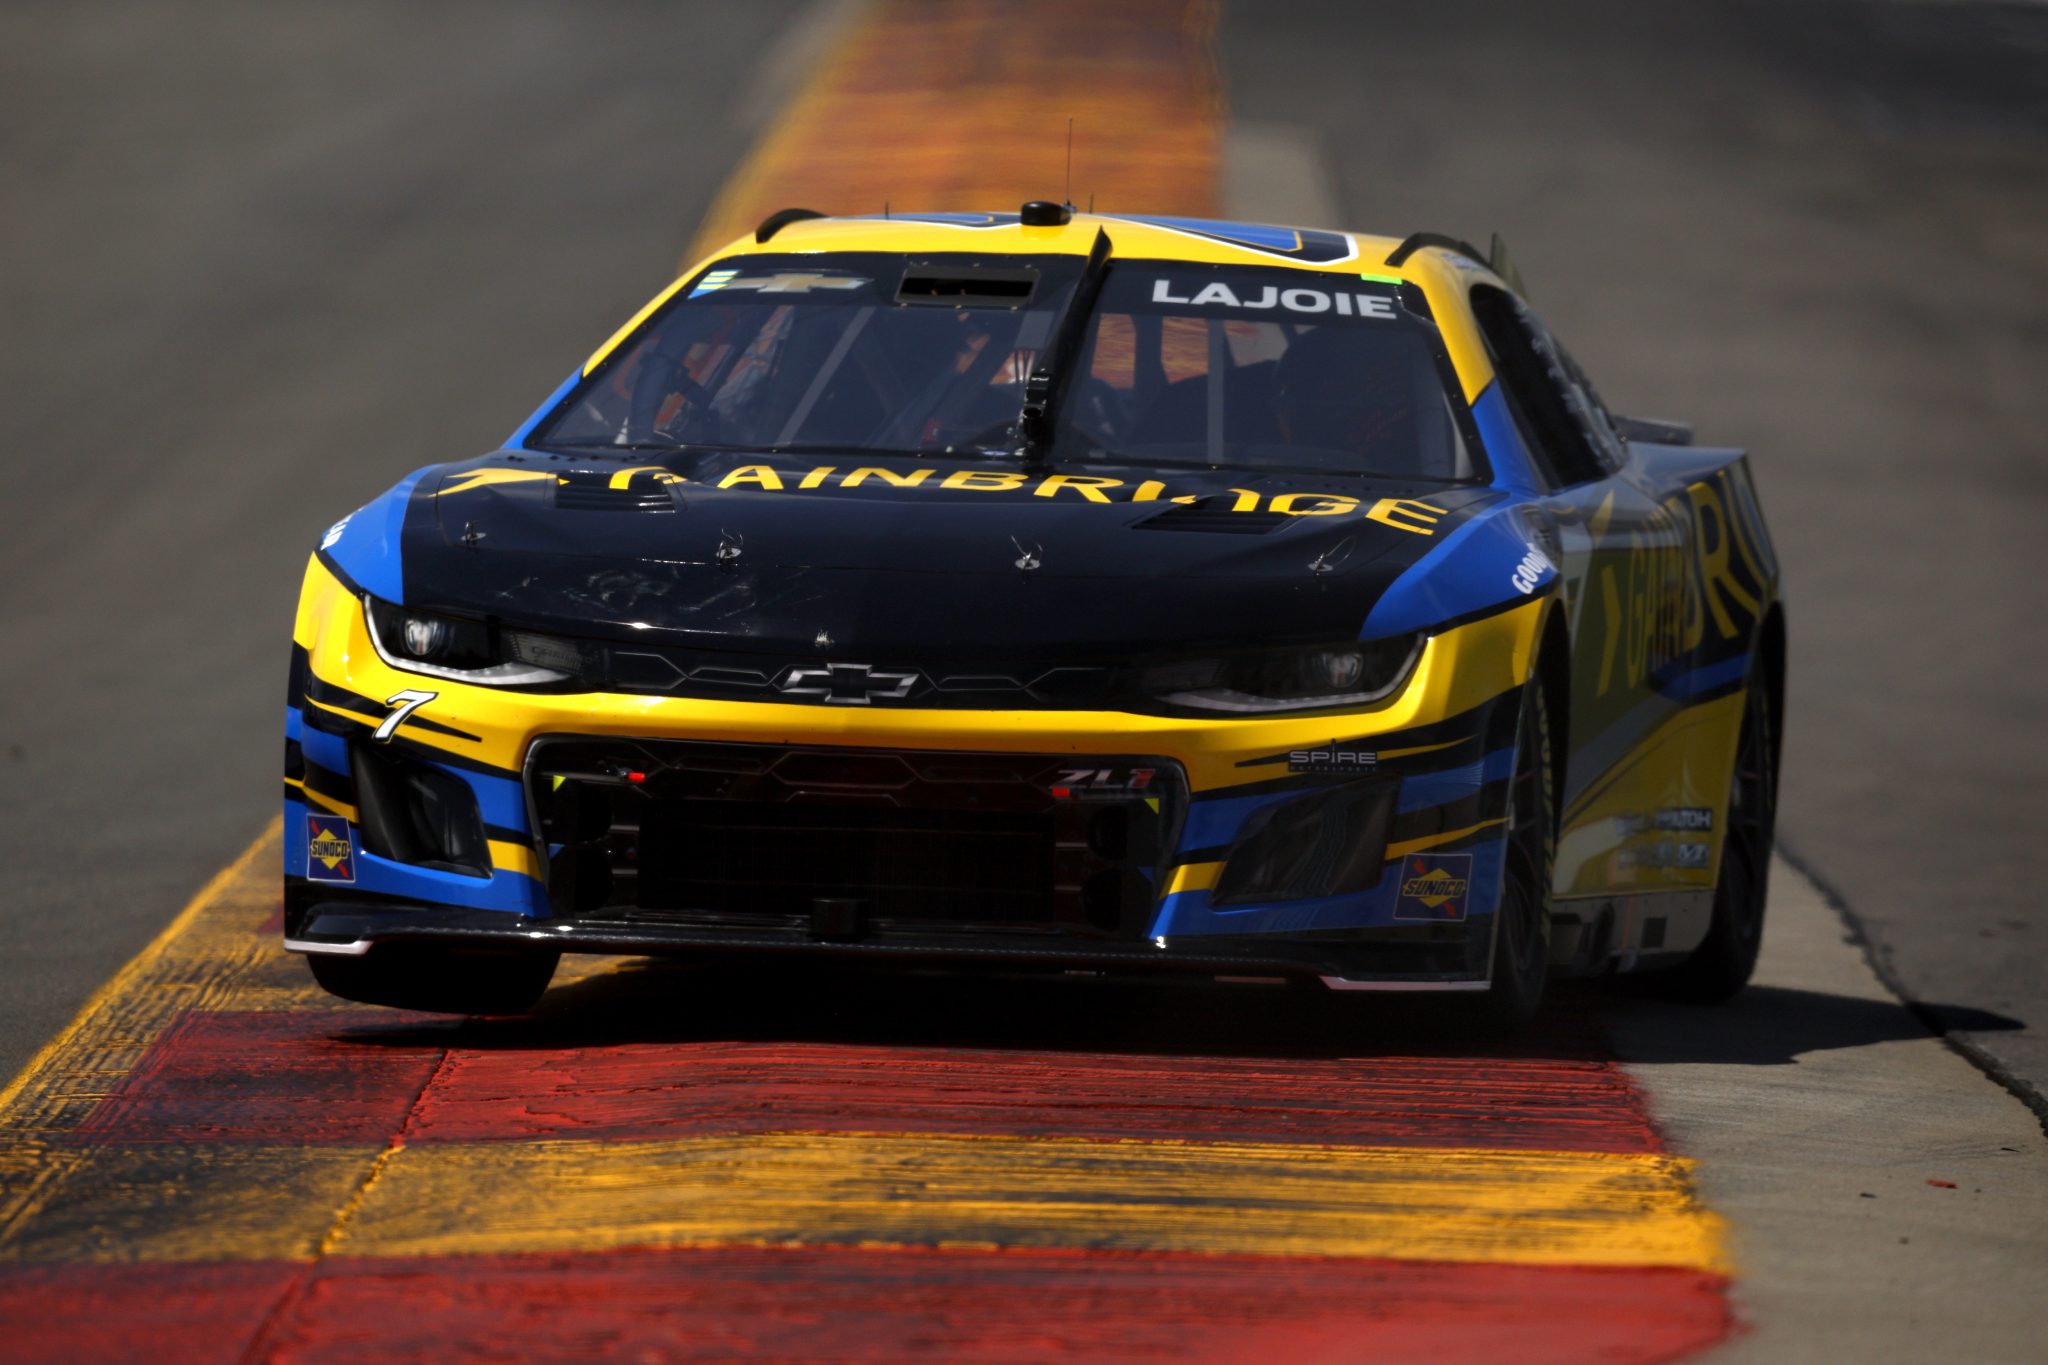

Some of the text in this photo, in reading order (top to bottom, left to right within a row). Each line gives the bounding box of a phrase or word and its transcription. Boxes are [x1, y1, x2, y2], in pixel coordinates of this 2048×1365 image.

[1152, 279, 1398, 320] LAJOIE
[372, 689, 439, 744] 7
[1289, 747, 1377, 765] SPIRE
[1048, 768, 1156, 789] ZL1
[311, 839, 349, 858] SUNOCO
[1403, 879, 1465, 897] SUNOCO
